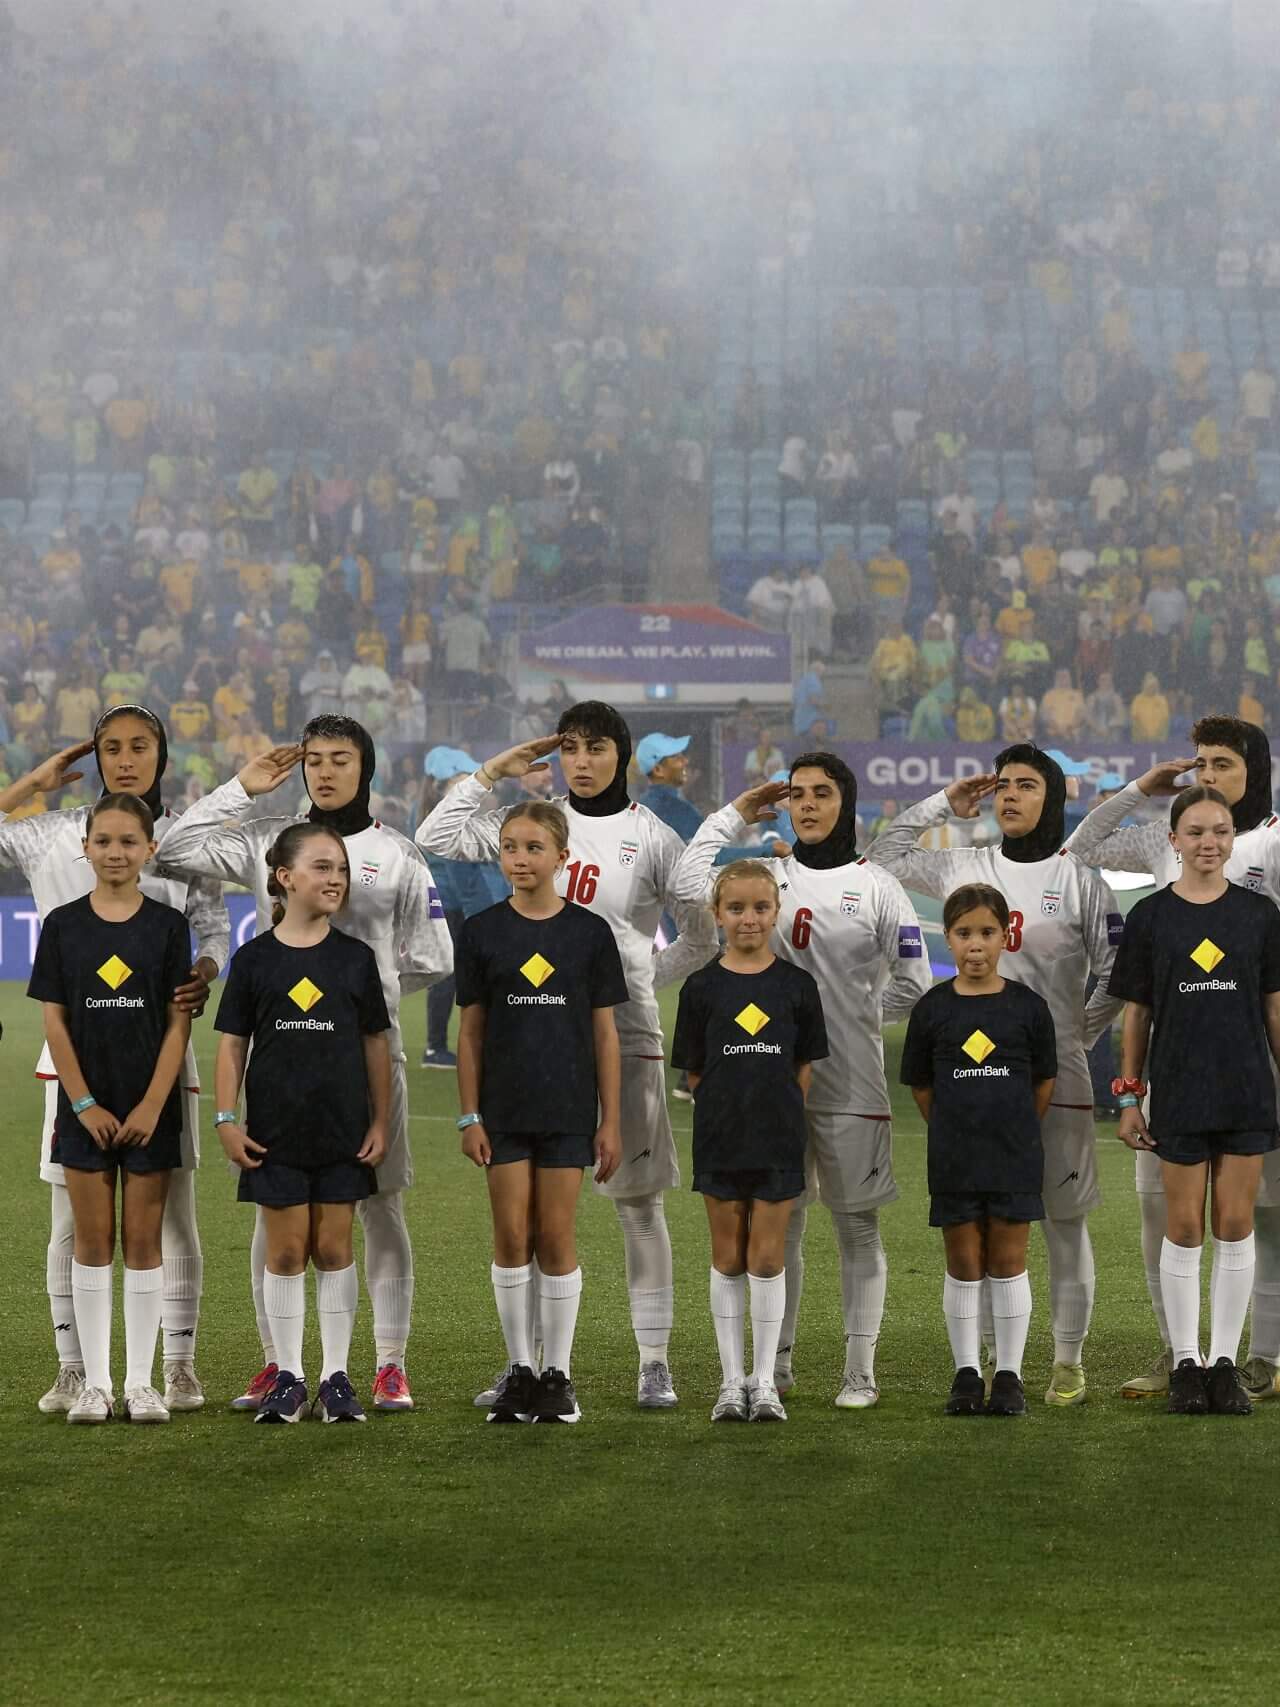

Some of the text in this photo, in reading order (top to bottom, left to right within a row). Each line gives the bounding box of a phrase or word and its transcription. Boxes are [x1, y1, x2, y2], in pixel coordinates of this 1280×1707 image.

[639, 615, 672, 632] 22
[535, 646, 561, 658] WE
[631, 646, 658, 658] WE
[709, 646, 736, 658] WE
[866, 755, 983, 786] GOLD
[566, 860, 600, 905] 16
[792, 907, 813, 950] 6
[1179, 979, 1238, 993] CommBank
[85, 996, 145, 1009] CommBank
[507, 993, 567, 1006] CommBank
[276, 1018, 335, 1032] CommBank
[723, 1042, 782, 1056] CommBank
[953, 1065, 1010, 1080] CommBank
